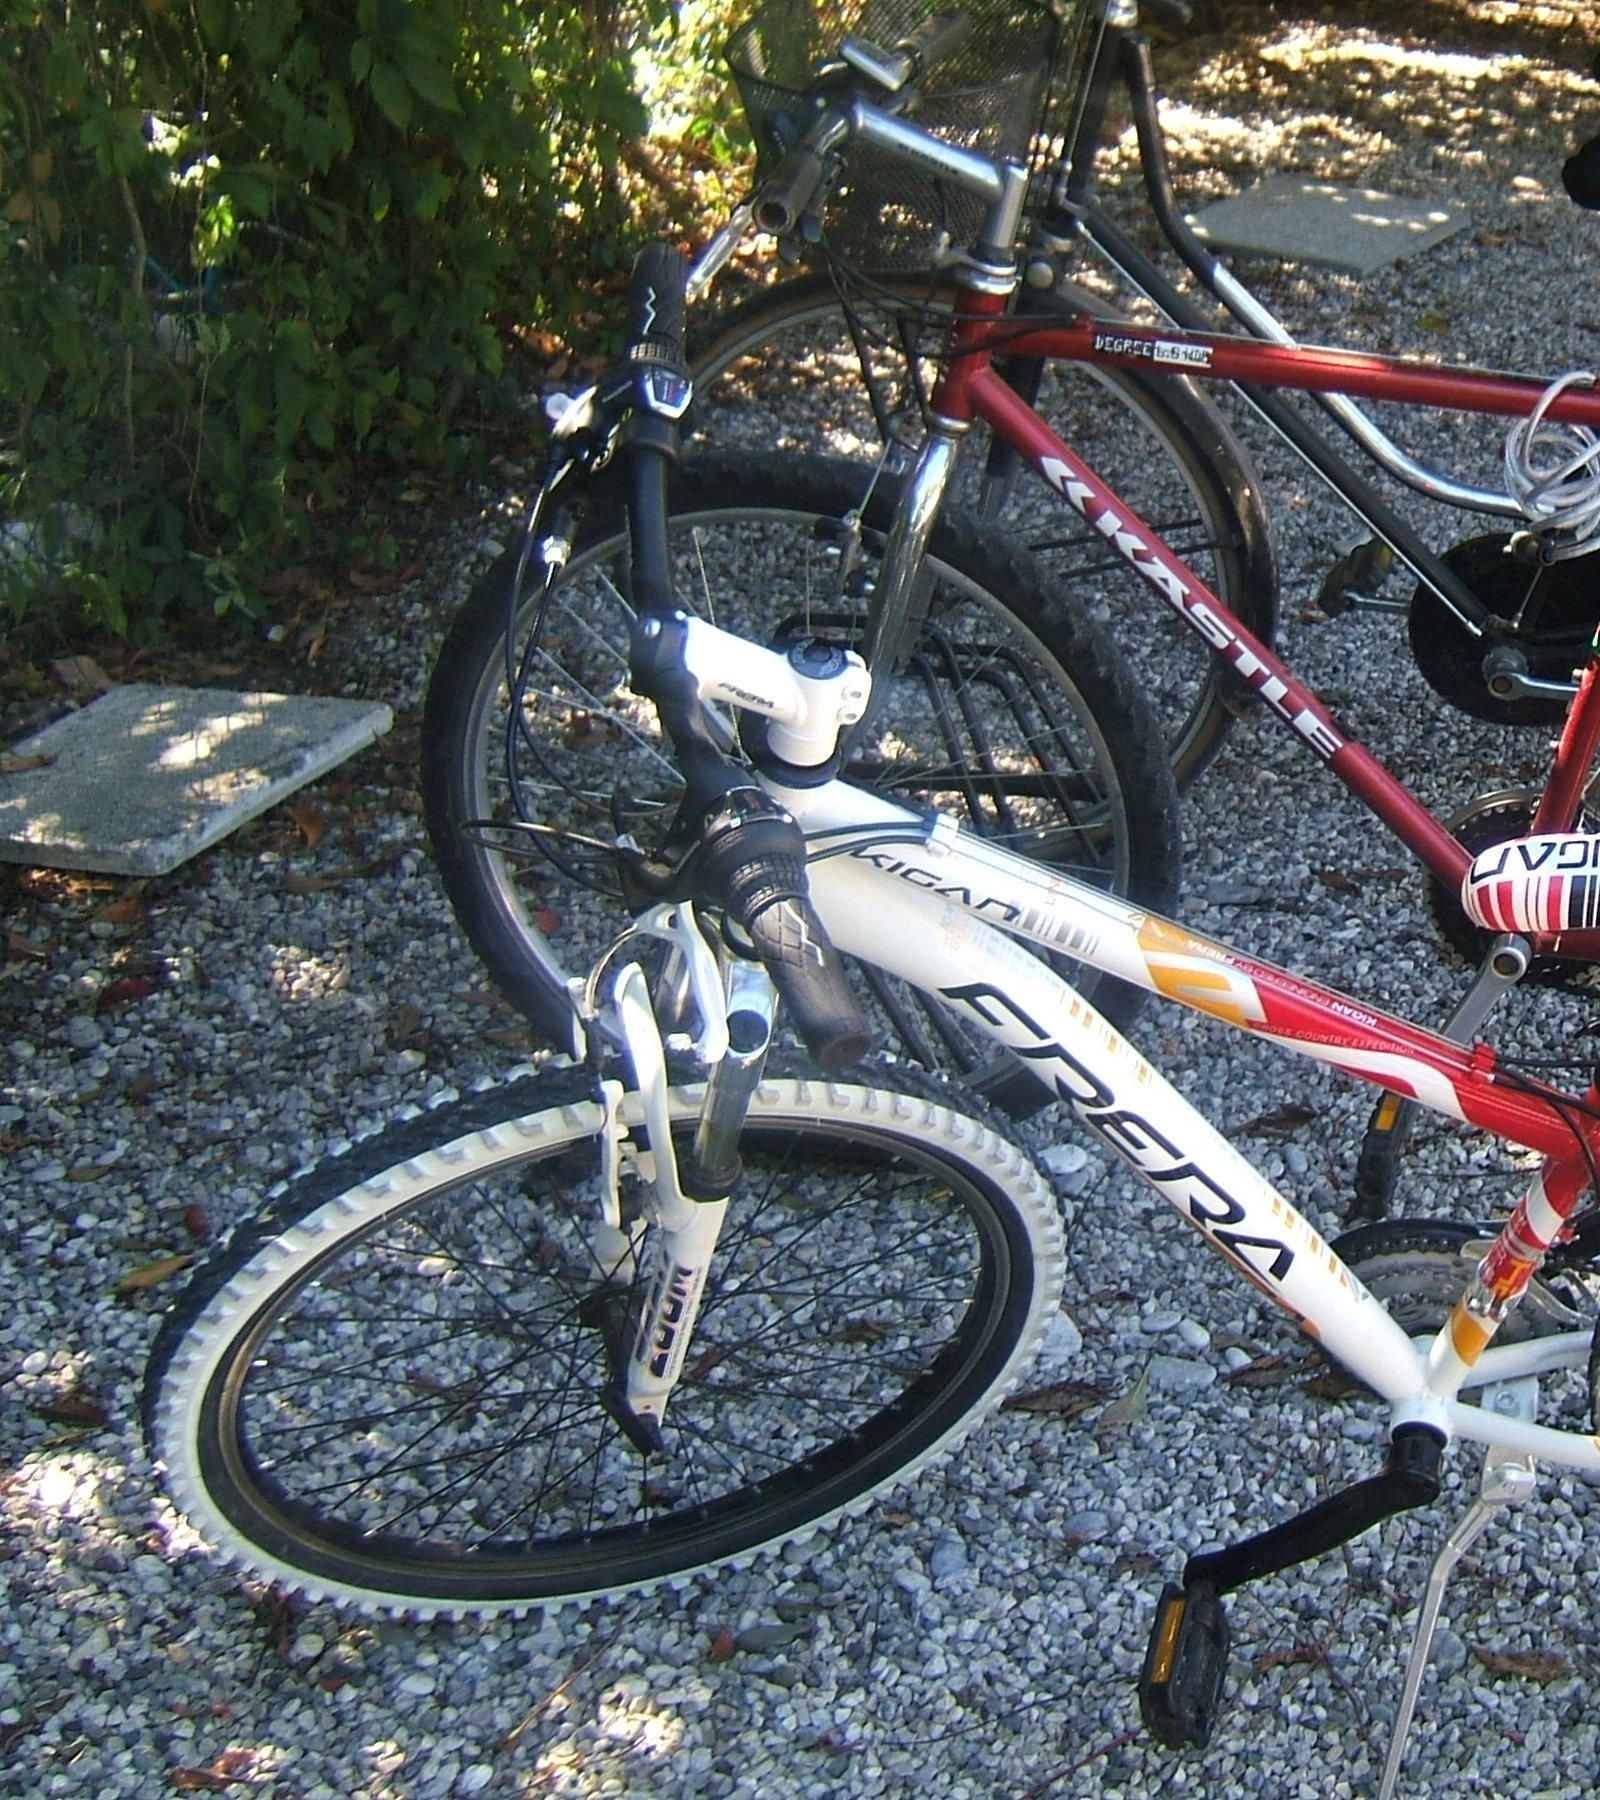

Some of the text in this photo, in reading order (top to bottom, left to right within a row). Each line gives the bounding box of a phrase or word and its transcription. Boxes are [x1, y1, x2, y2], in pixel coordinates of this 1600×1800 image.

[1094, 334, 1152, 358] DEGREE
[1094, 508, 1343, 760] KASTLE
[849, 846, 1023, 923] KIGAN
[1331, 1001, 1378, 1028] KIGAN
[938, 981, 1294, 1282] FRERA
